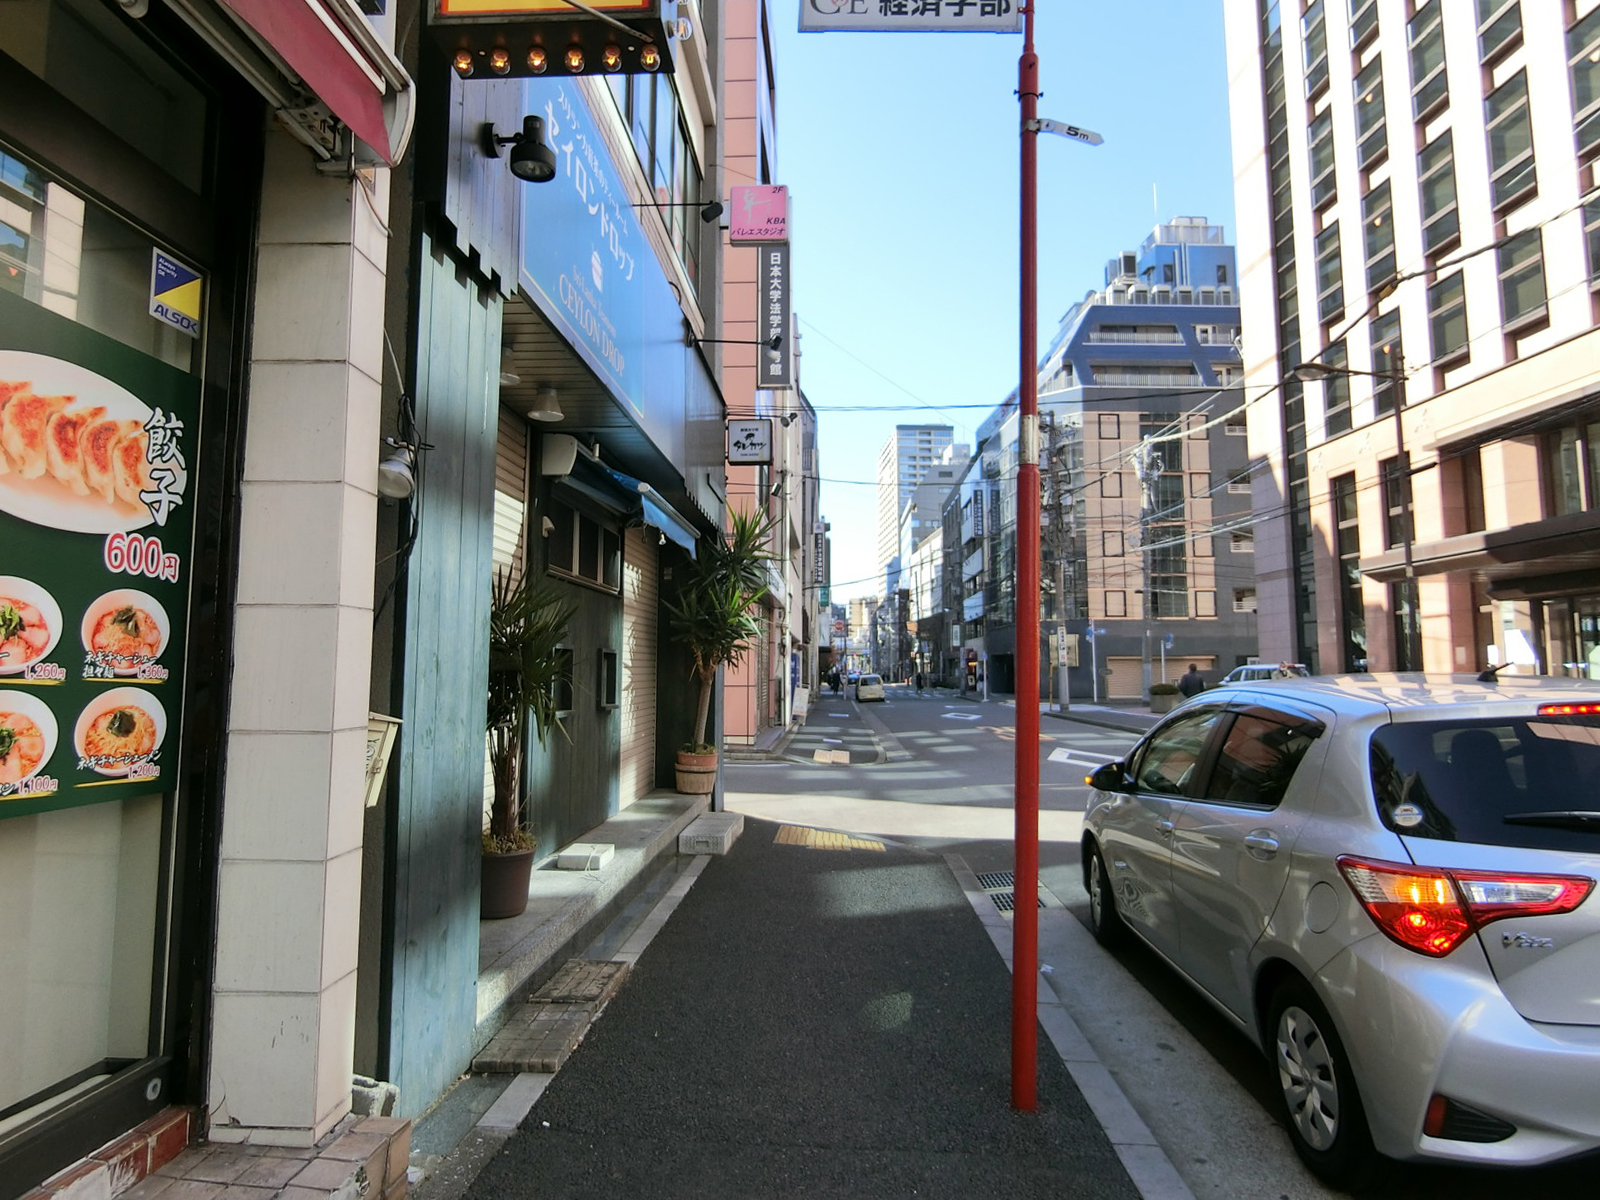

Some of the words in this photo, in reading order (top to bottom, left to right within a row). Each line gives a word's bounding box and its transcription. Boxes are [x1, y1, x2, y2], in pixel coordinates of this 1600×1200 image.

[1065, 126, 1089, 141] 5m
[544, 98, 635, 282] セイロンドロップ
[771, 186, 784, 194] 2F
[766, 217, 786, 225] KBA
[153, 304, 199, 335] ALSOK
[769, 252, 782, 376] 日本大学法学部号館
[559, 273, 601, 348] CEYLON
[602, 331, 625, 377] DROP
[139, 406, 187, 527] 餃子
[105, 531, 181, 584] 600円
[83, 651, 159, 664] ネギチャーシュー
[25, 662, 66, 680] 1,260円
[82, 664, 115, 678] 担々麺
[18, 775, 58, 796] 1,100円
